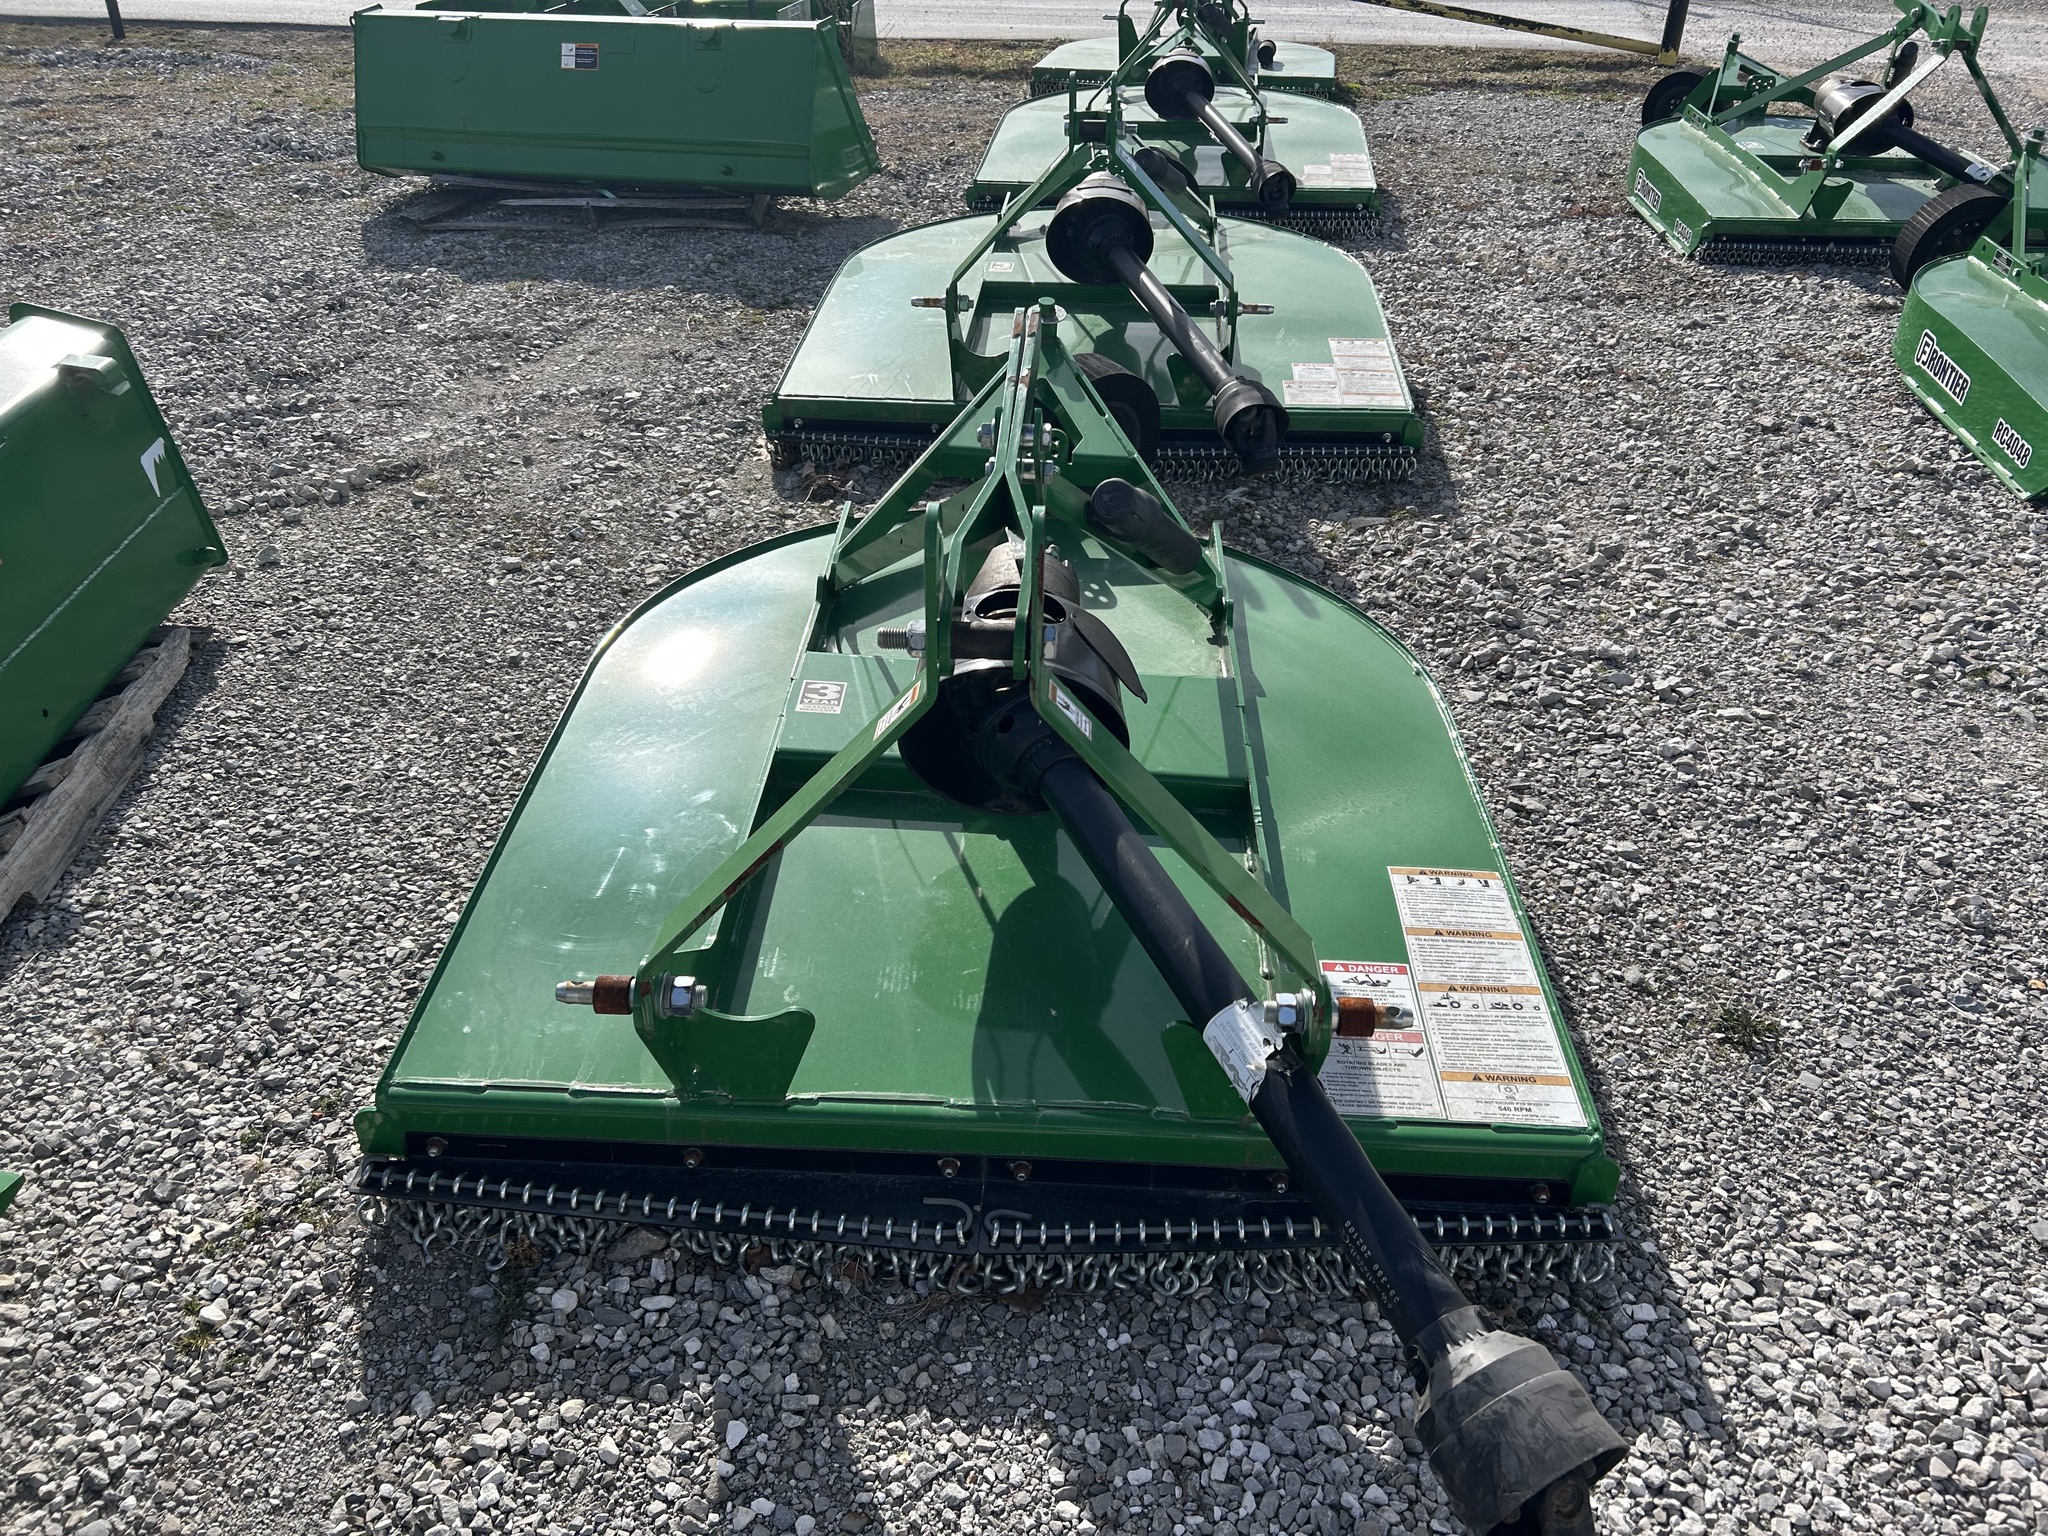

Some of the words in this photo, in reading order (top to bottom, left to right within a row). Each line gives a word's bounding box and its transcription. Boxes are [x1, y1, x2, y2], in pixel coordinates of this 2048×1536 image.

[1634, 169, 1661, 213] FRONTIER
[1674, 219, 1692, 245] RC4048
[1916, 332, 1969, 403] FRONTIER
[1993, 420, 2031, 467] RC4048
[805, 683, 841, 700] 3
[1446, 930, 1493, 938] WARNING
[1348, 965, 1399, 974] DANGER
[1459, 985, 1509, 993] WARNING
[1367, 1033, 1404, 1041] NGER
[1485, 1074, 1537, 1083] WARNING
[1344, 1220, 1372, 1258] 202108
